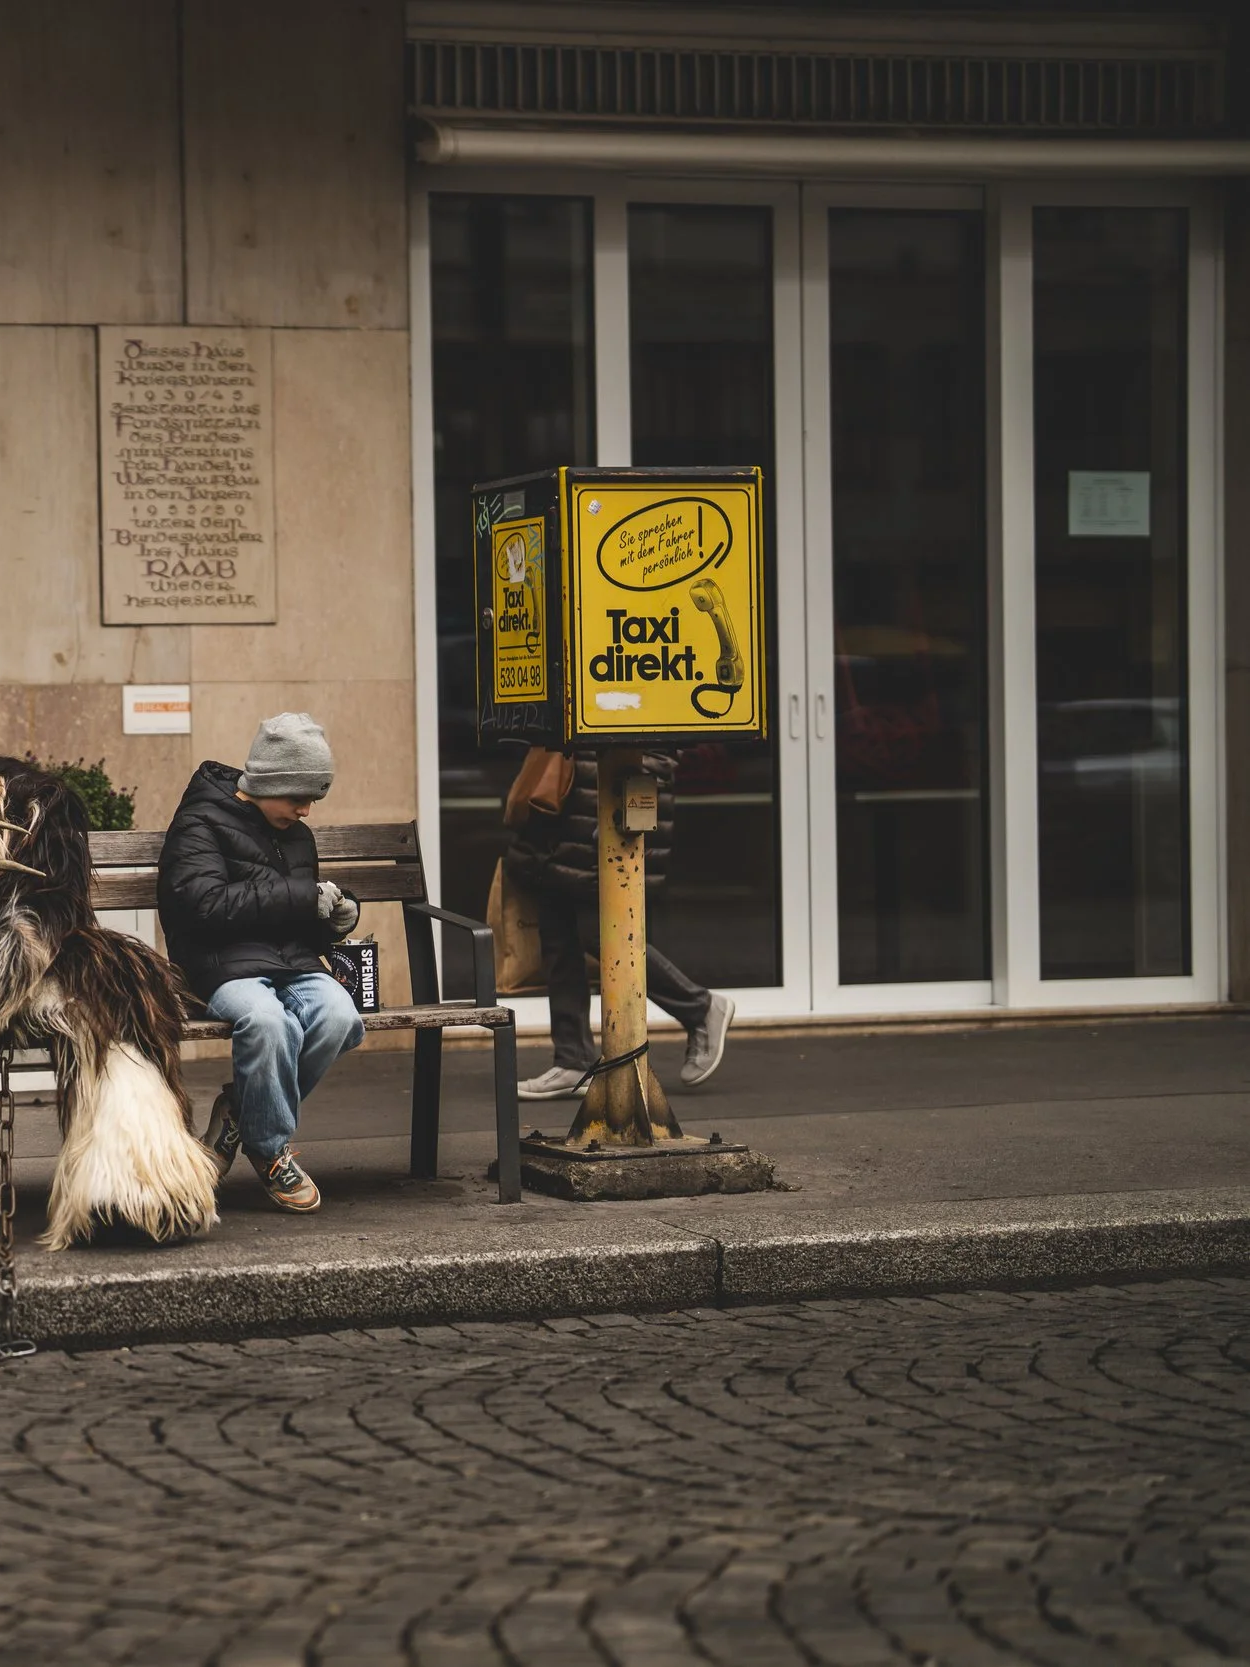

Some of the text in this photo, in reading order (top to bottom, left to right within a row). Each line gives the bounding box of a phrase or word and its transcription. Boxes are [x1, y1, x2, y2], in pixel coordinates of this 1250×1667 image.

[192, 359, 215, 371] in
[217, 360, 256, 372] den
[129, 431, 163, 442] des
[124, 486, 252, 501] in den Jahren
[619, 514, 683, 549] Sie sprechen
[176, 543, 239, 558] Julius
[620, 528, 695, 567] mit dem Fahrer
[140, 559, 237, 579] RAAB
[642, 542, 694, 583] persönlich
[503, 584, 525, 609] Taxi
[499, 610, 532, 633] direkt.
[606, 607, 680, 644] Taxi
[589, 645, 703, 682] direkt.
[501, 665, 541, 688] 533 04 98
[361, 949, 375, 1008] SPENDEN
